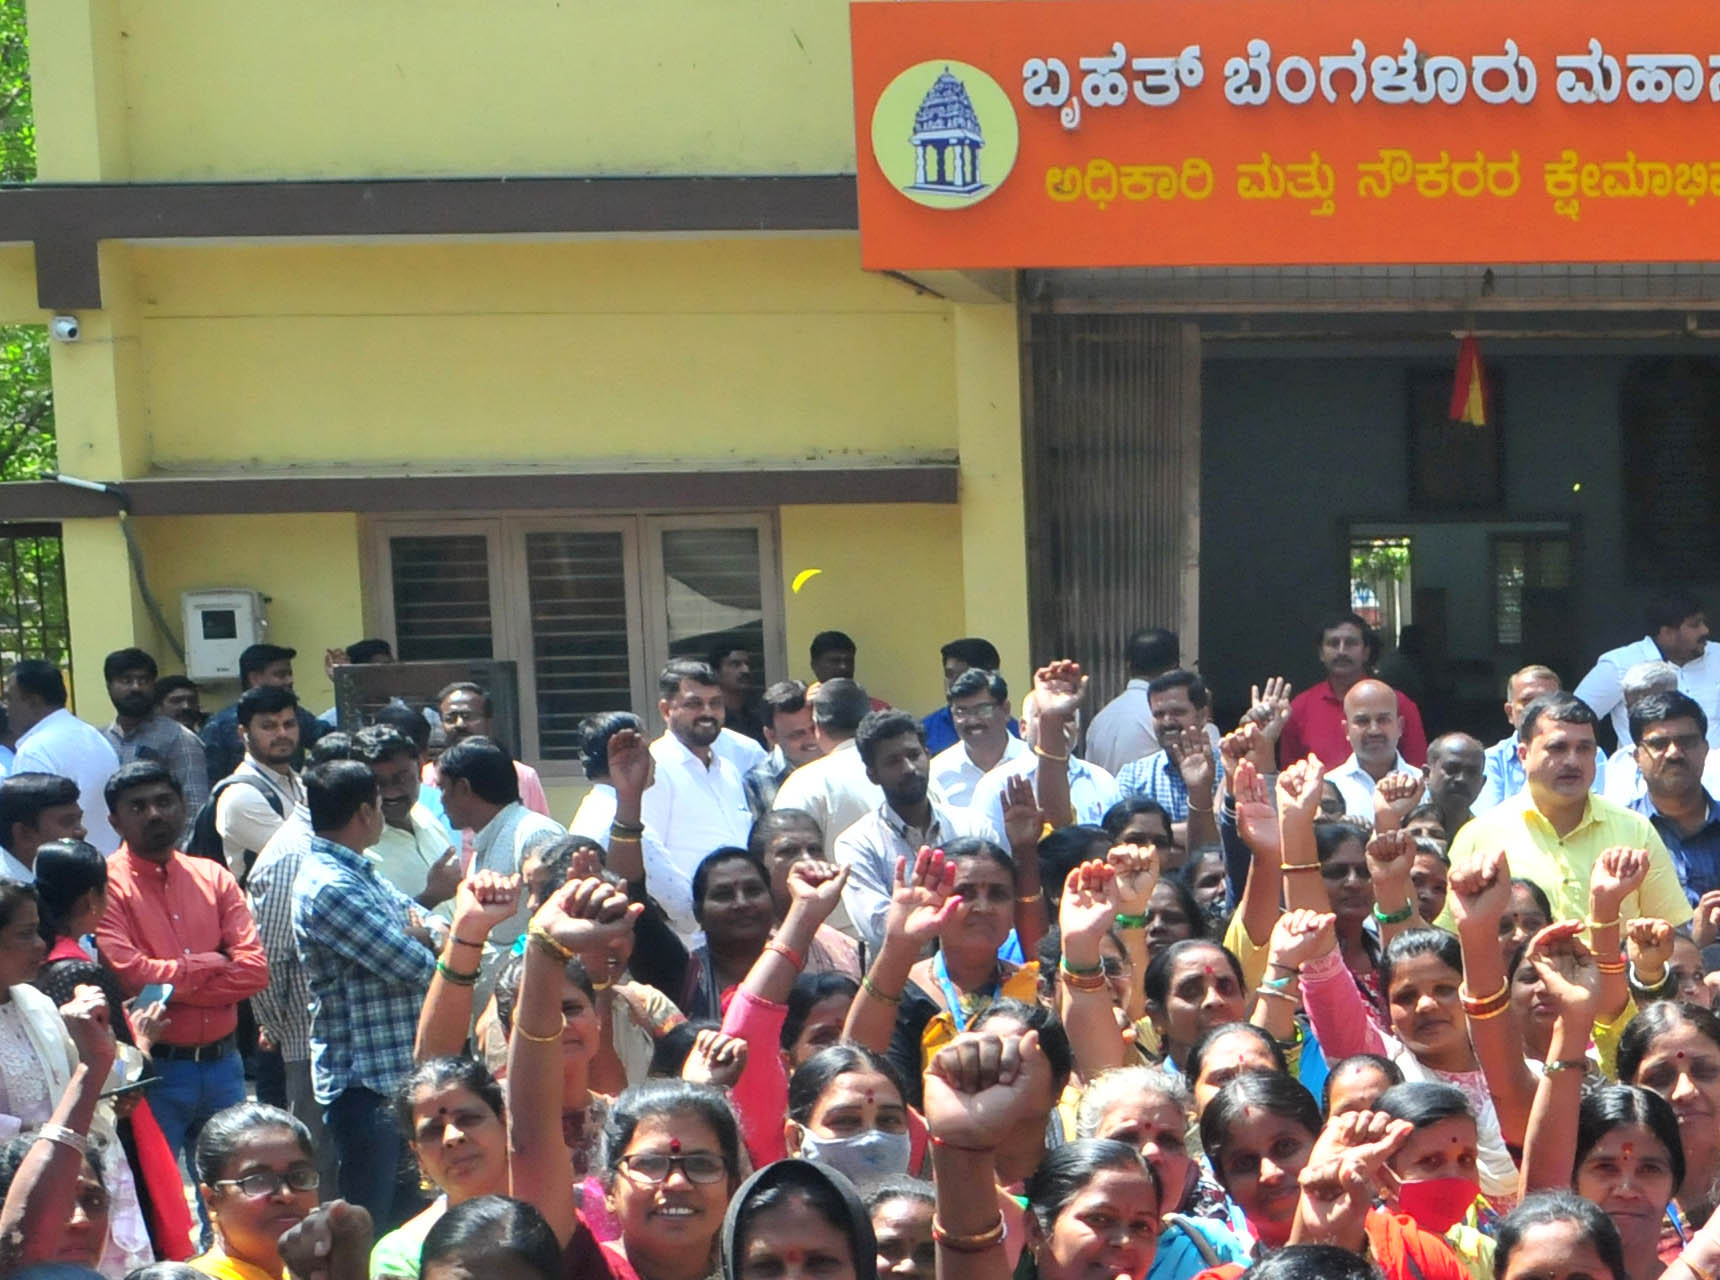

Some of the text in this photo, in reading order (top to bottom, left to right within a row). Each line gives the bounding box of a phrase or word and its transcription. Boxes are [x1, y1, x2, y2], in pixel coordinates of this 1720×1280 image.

[1022, 41, 1205, 130] ಬೃಹತ್
[1223, 37, 1538, 106] ಬೆಂಗಳೂರು
[1045, 157, 1214, 210] ಅಧಿಕಾರಿ
[1237, 151, 1336, 216] ಮತ್ತು
[1357, 148, 1522, 198] ನೌಕರರ
